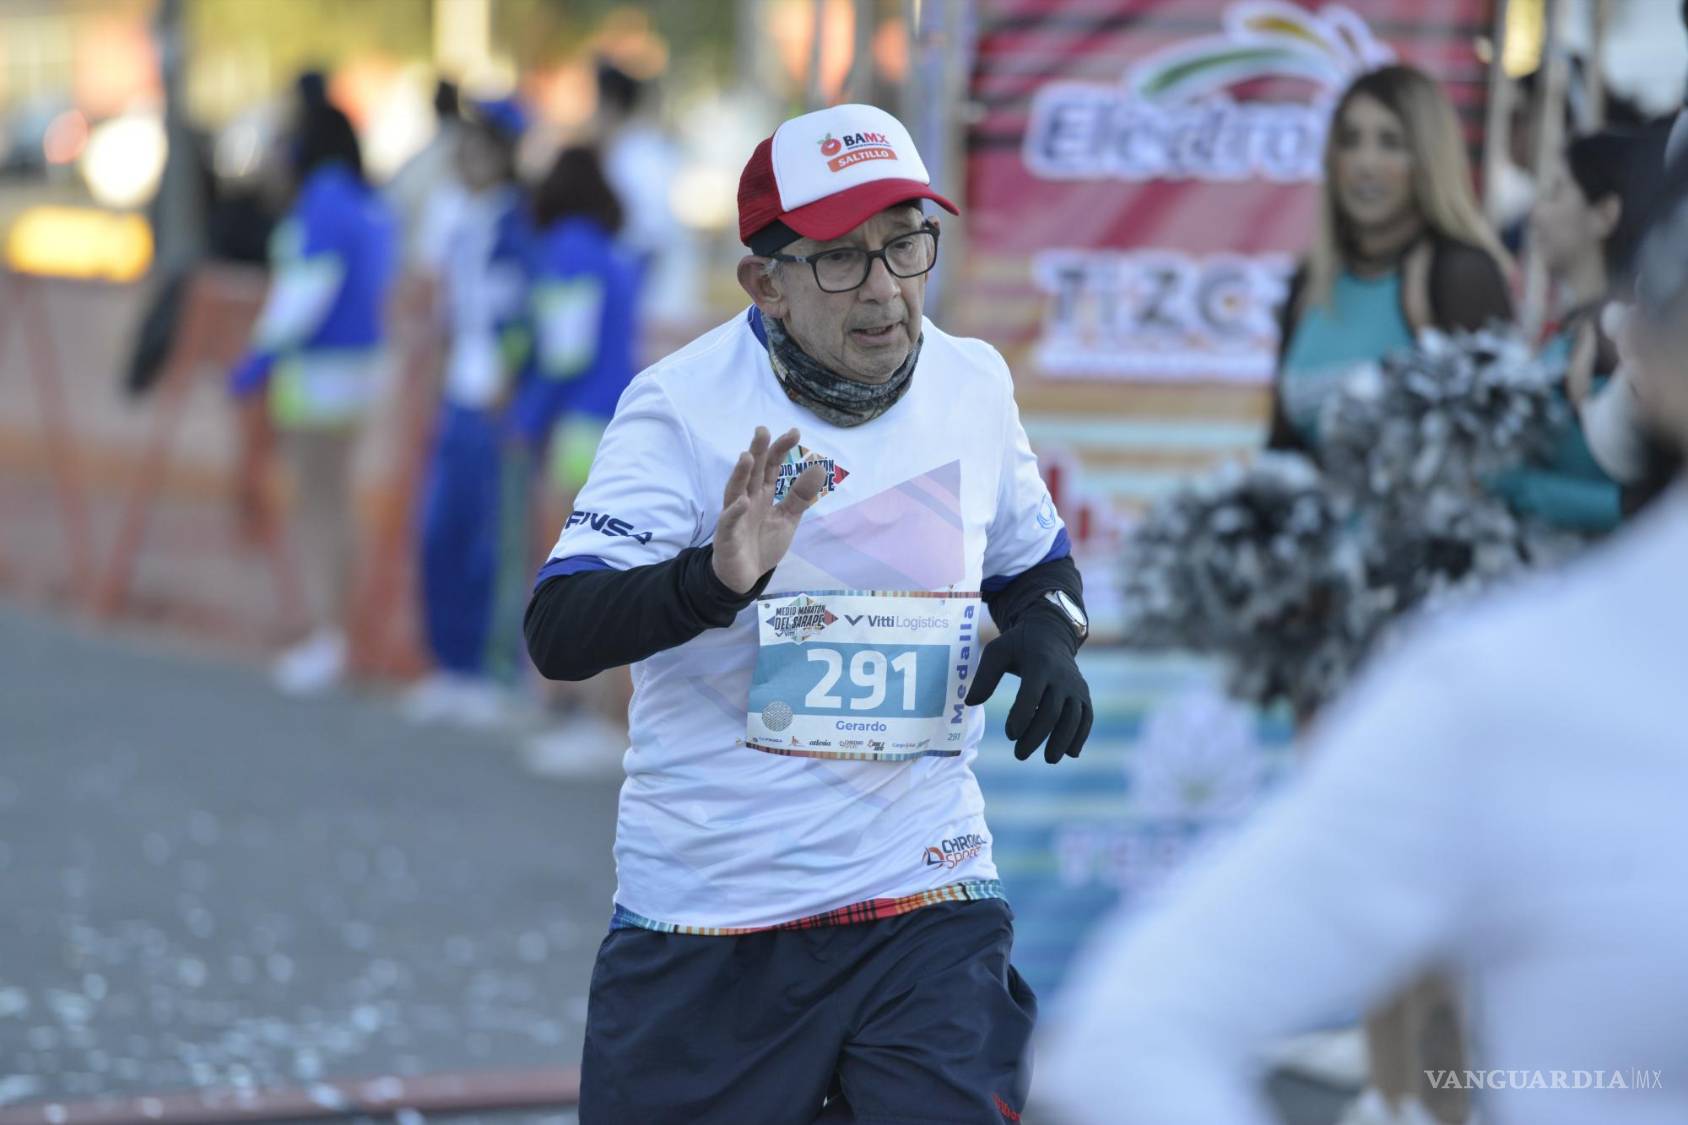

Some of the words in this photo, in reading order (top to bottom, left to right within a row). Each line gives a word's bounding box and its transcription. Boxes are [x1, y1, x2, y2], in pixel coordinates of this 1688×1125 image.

[842, 132, 890, 147] BAMX
[838, 150, 889, 167] SALTILLO
[775, 606, 797, 616] MEDIO
[774, 616, 790, 630] DEL
[792, 614, 824, 629] SARAPE
[868, 615, 895, 628] Vitti
[896, 616, 950, 630] Logistics
[951, 605, 975, 725] Medalla
[804, 648, 917, 711] 291
[835, 720, 887, 732] Gerardo
